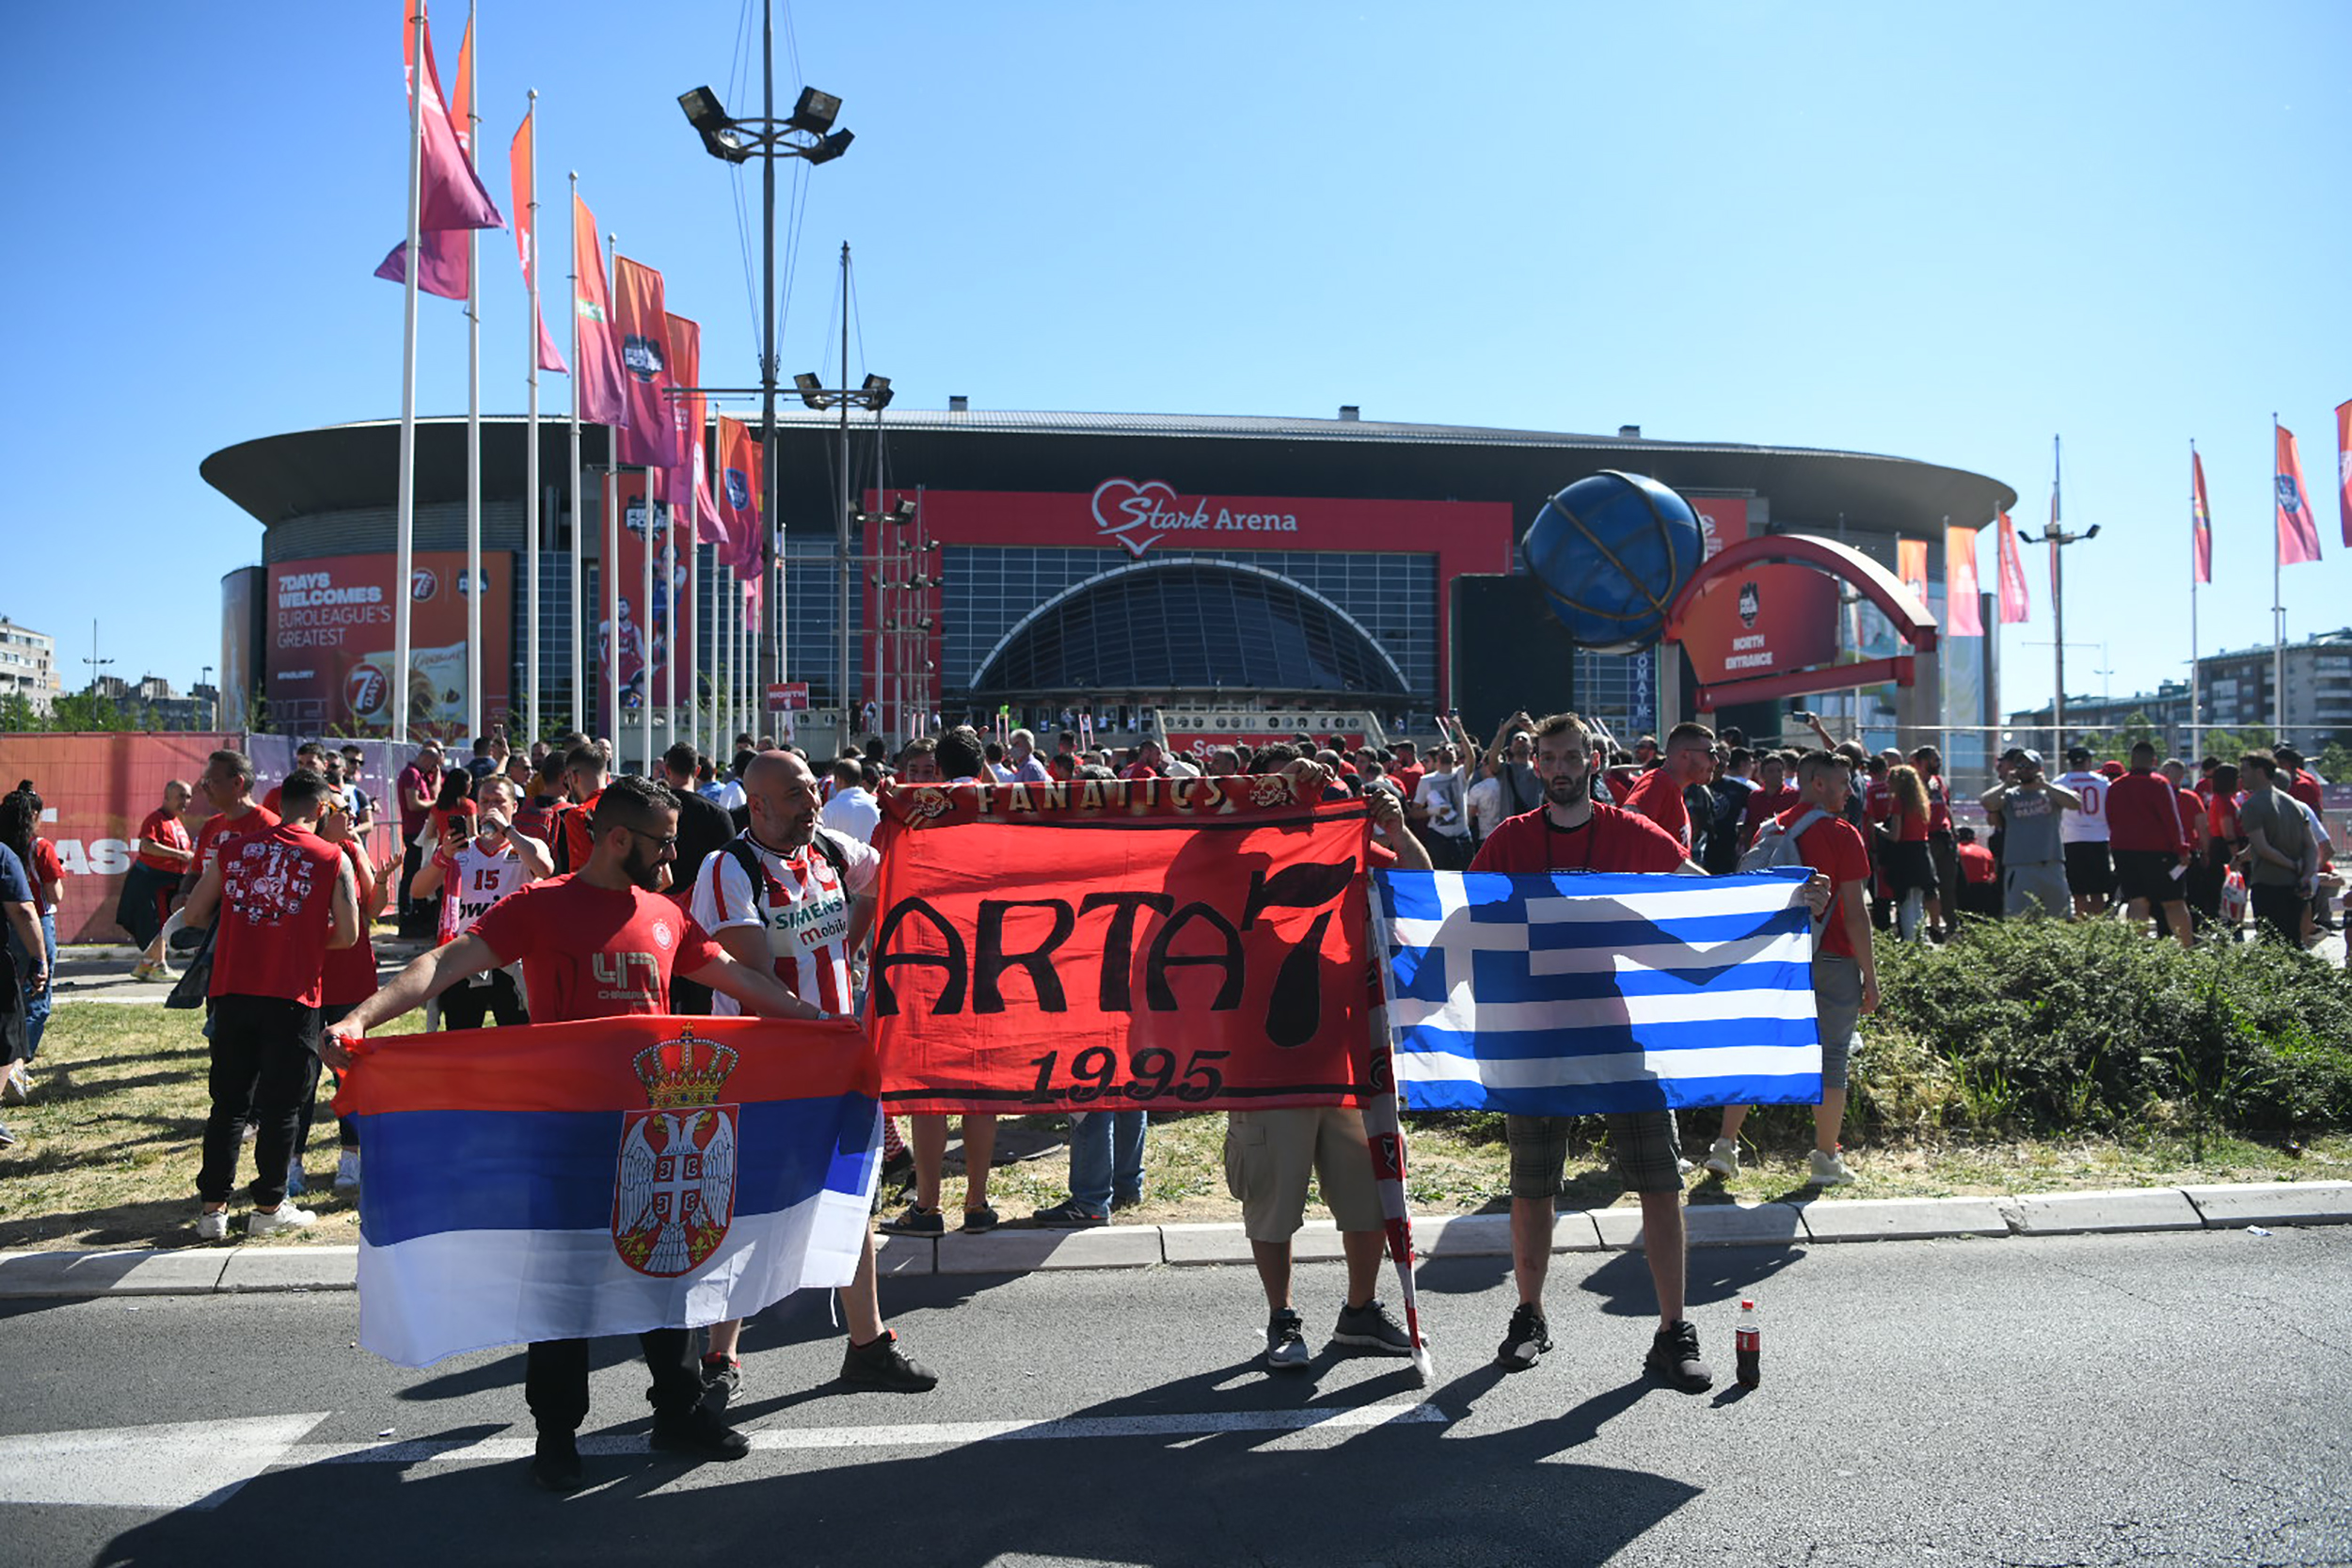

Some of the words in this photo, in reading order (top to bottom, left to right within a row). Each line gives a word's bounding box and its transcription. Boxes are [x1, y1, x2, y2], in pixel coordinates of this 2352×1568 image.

[1096, 497, 1209, 535] Stark
[1214, 508, 1298, 531] Arena
[278, 572, 330, 593] 7DAYS
[278, 586, 382, 610] WELCOMES
[278, 605, 391, 628] EUROLEAGUE'S
[278, 627, 345, 648] GREATEST
[1733, 634, 1765, 651] NORTH
[1725, 651, 1773, 670] ENTRANCE
[352, 671, 376, 710] 7
[365, 675, 383, 707] DAYS
[784, 699, 790, 709] 1
[977, 777, 1225, 813] FANATICS
[474, 869, 500, 890] 15
[775, 896, 843, 929] SIMENS
[875, 892, 1245, 1016] ARTA
[1022, 1046, 1231, 1104] 1995
